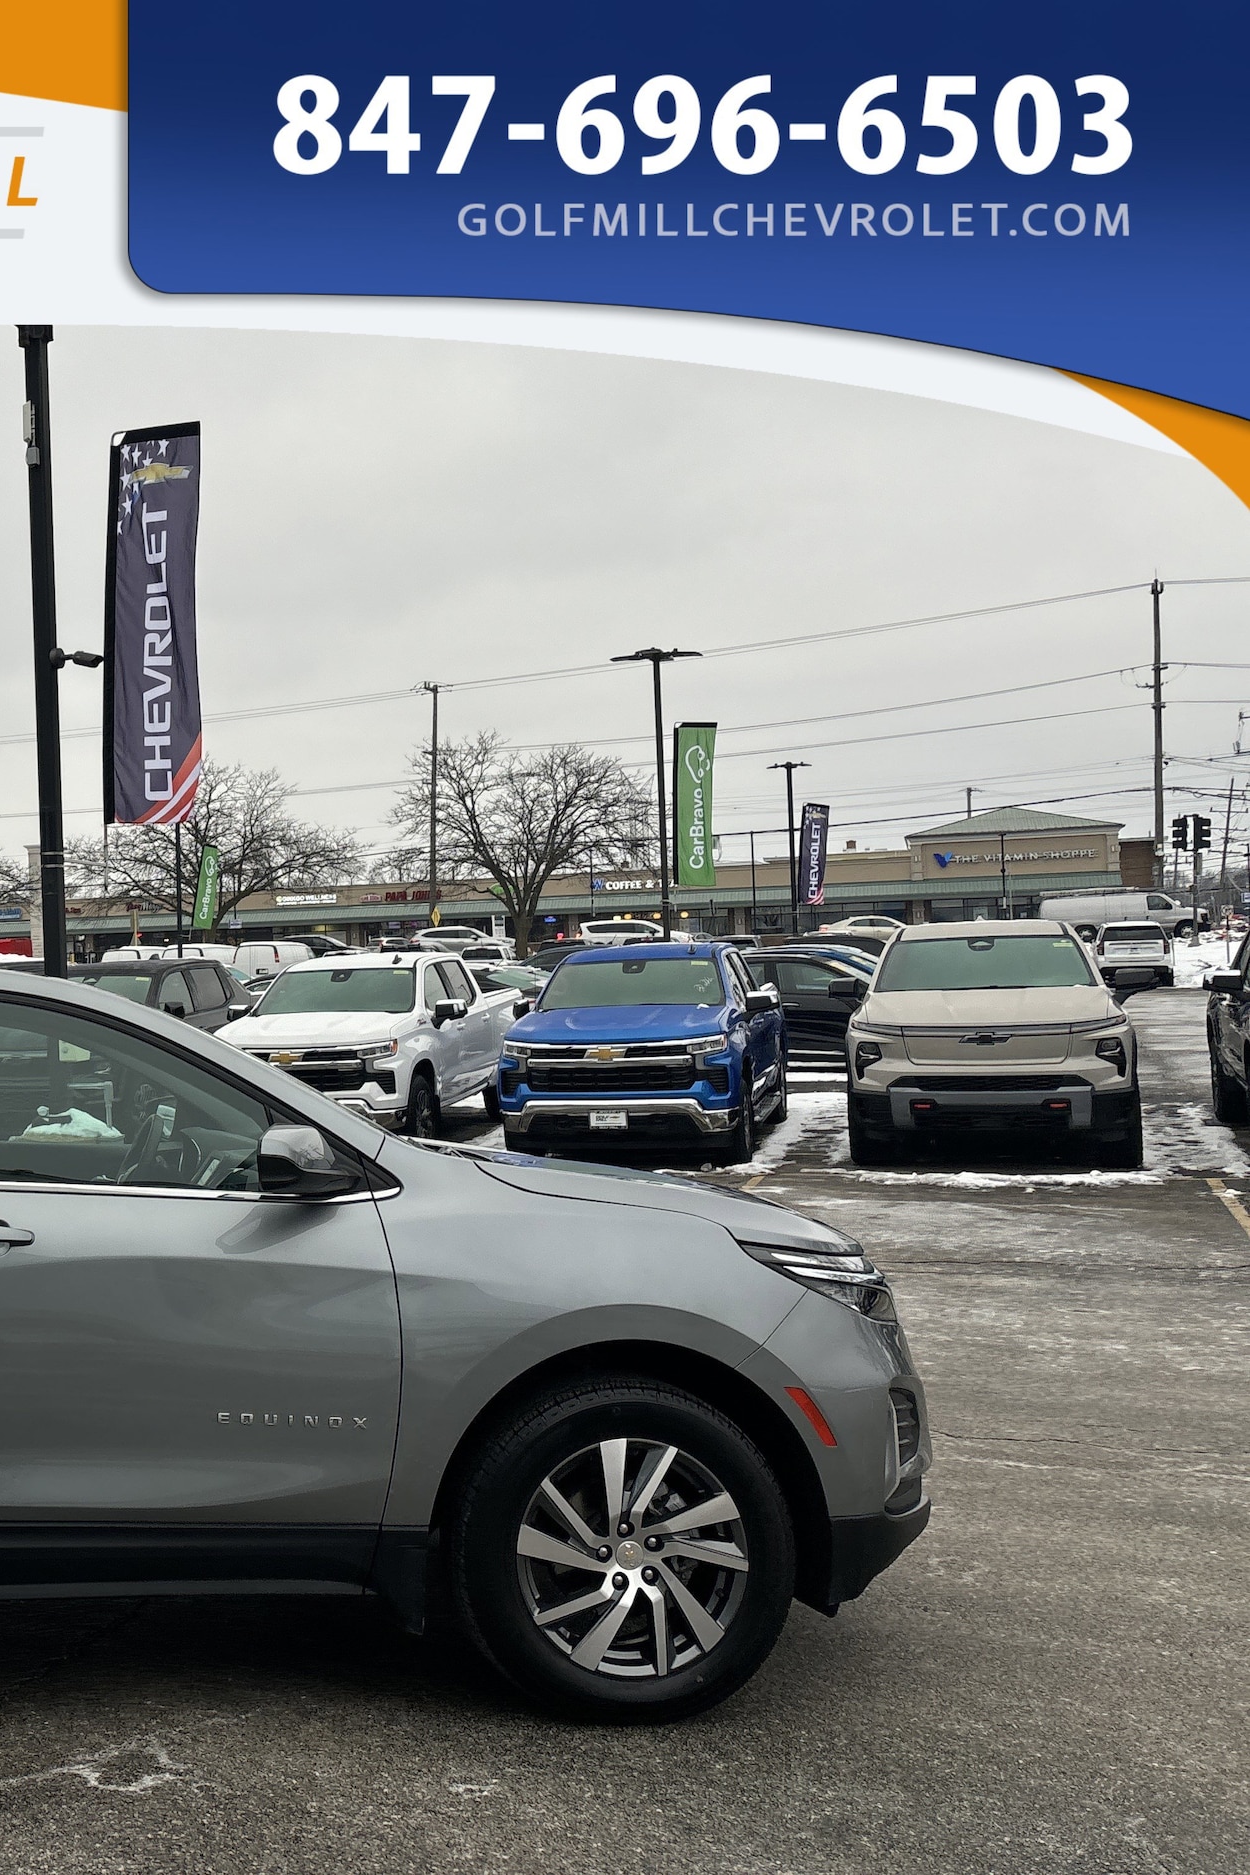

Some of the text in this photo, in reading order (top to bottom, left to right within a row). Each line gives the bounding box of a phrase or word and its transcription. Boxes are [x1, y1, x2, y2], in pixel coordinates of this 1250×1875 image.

[142, 502, 174, 801] CHEVROLET
[689, 788, 705, 870] CarBravo
[808, 822, 821, 899] CHEVROLET
[954, 848, 1096, 864] THE VITAMIN SHOPPE
[199, 878, 213, 920] CarBravo
[385, 891, 408, 901] PAPA
[605, 880, 642, 891] COFFEE
[645, 880, 654, 889] &
[217, 1412, 367, 1429] EQUINOX
